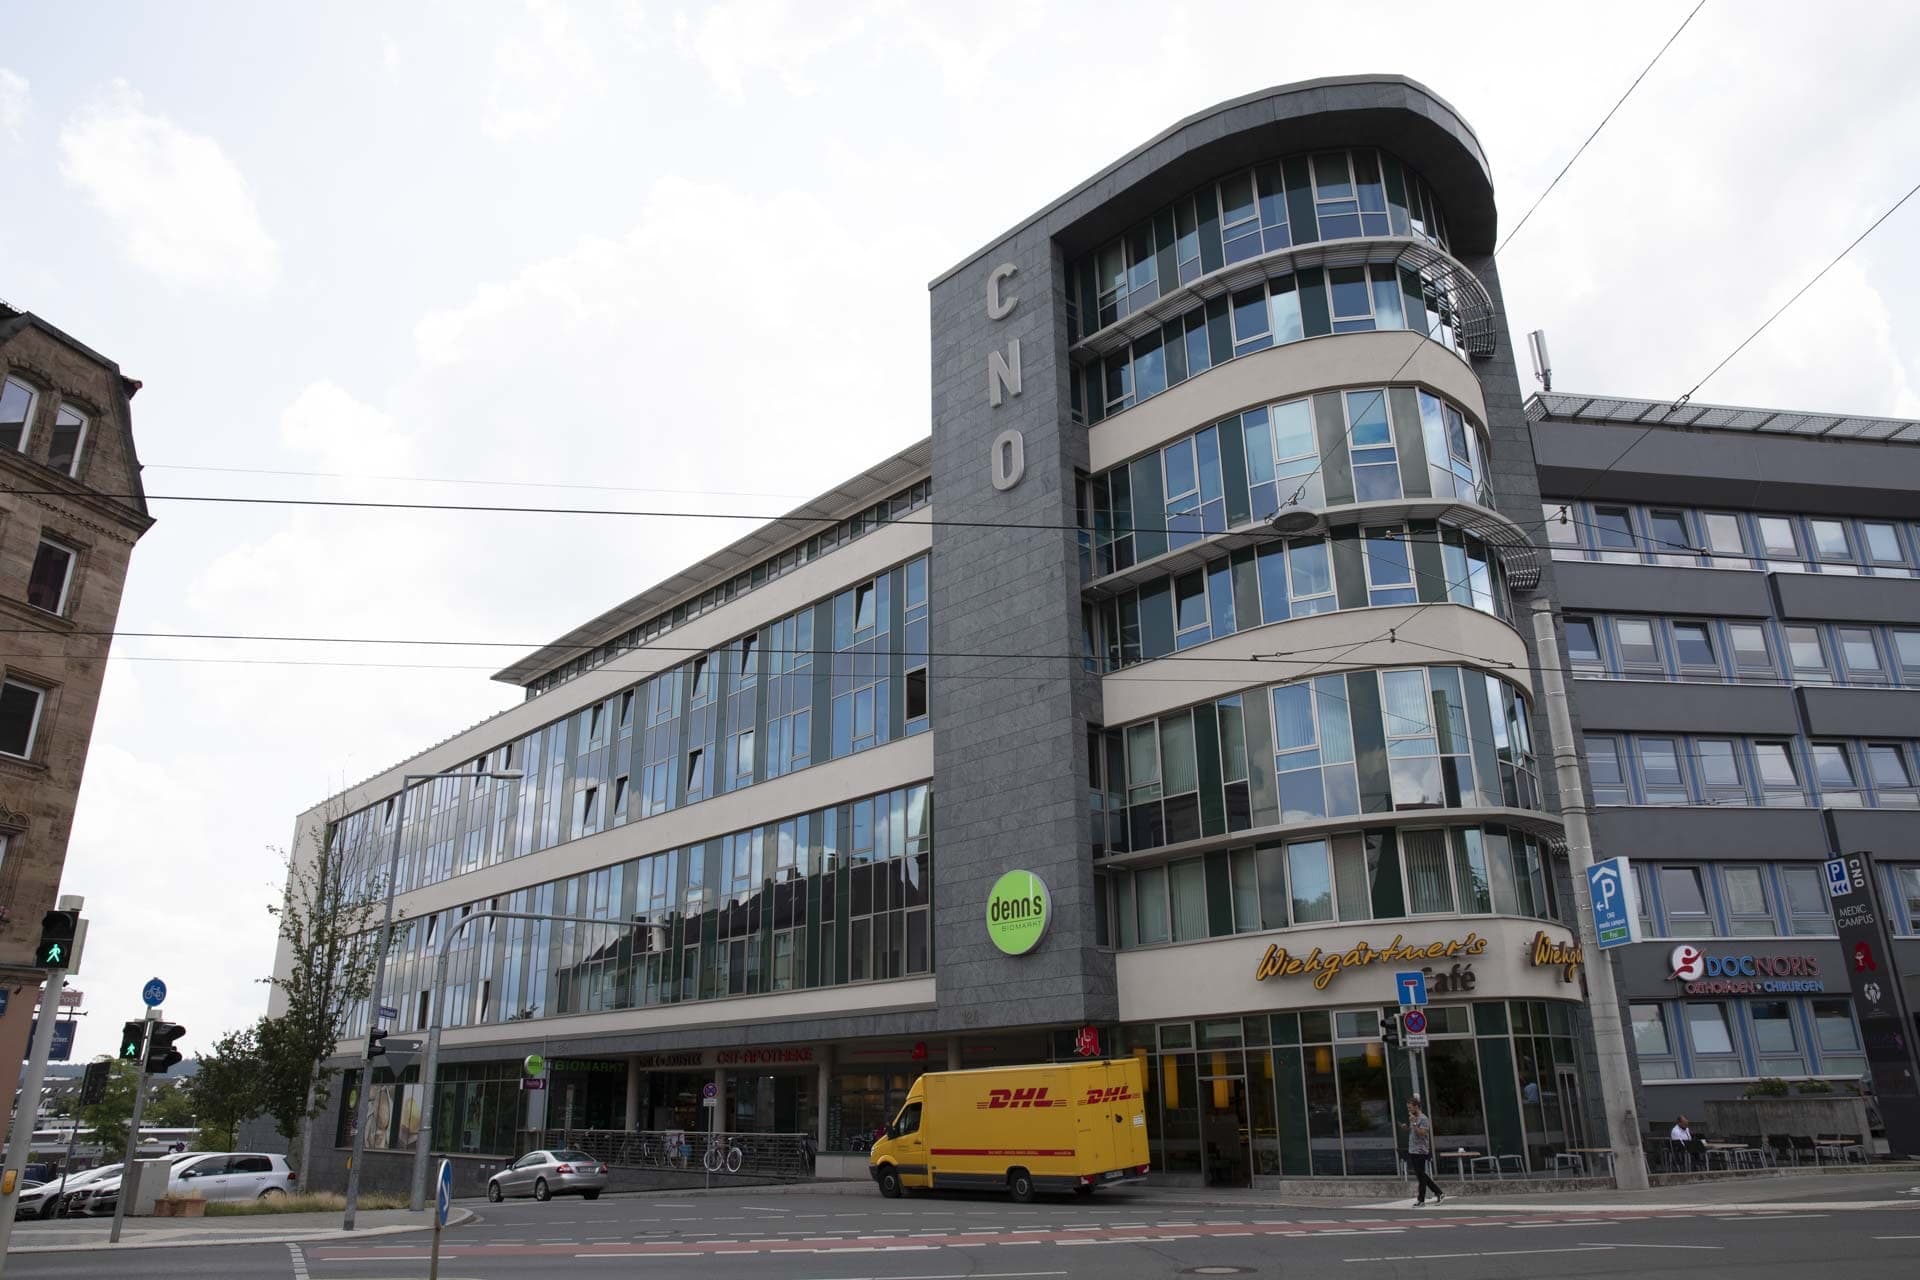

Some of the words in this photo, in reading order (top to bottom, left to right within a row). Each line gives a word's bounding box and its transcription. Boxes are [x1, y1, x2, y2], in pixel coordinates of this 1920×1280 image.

[987, 262, 1025, 491] CNO
[1831, 863, 1840, 881] P
[1849, 858, 1865, 888] CNO
[1601, 878, 1616, 910] P
[1837, 913, 1874, 928] CAMPUS
[1840, 904, 1867, 918] MEDIC
[989, 1087, 1054, 1109] DHL
[1087, 1086, 1131, 1104] DHL
